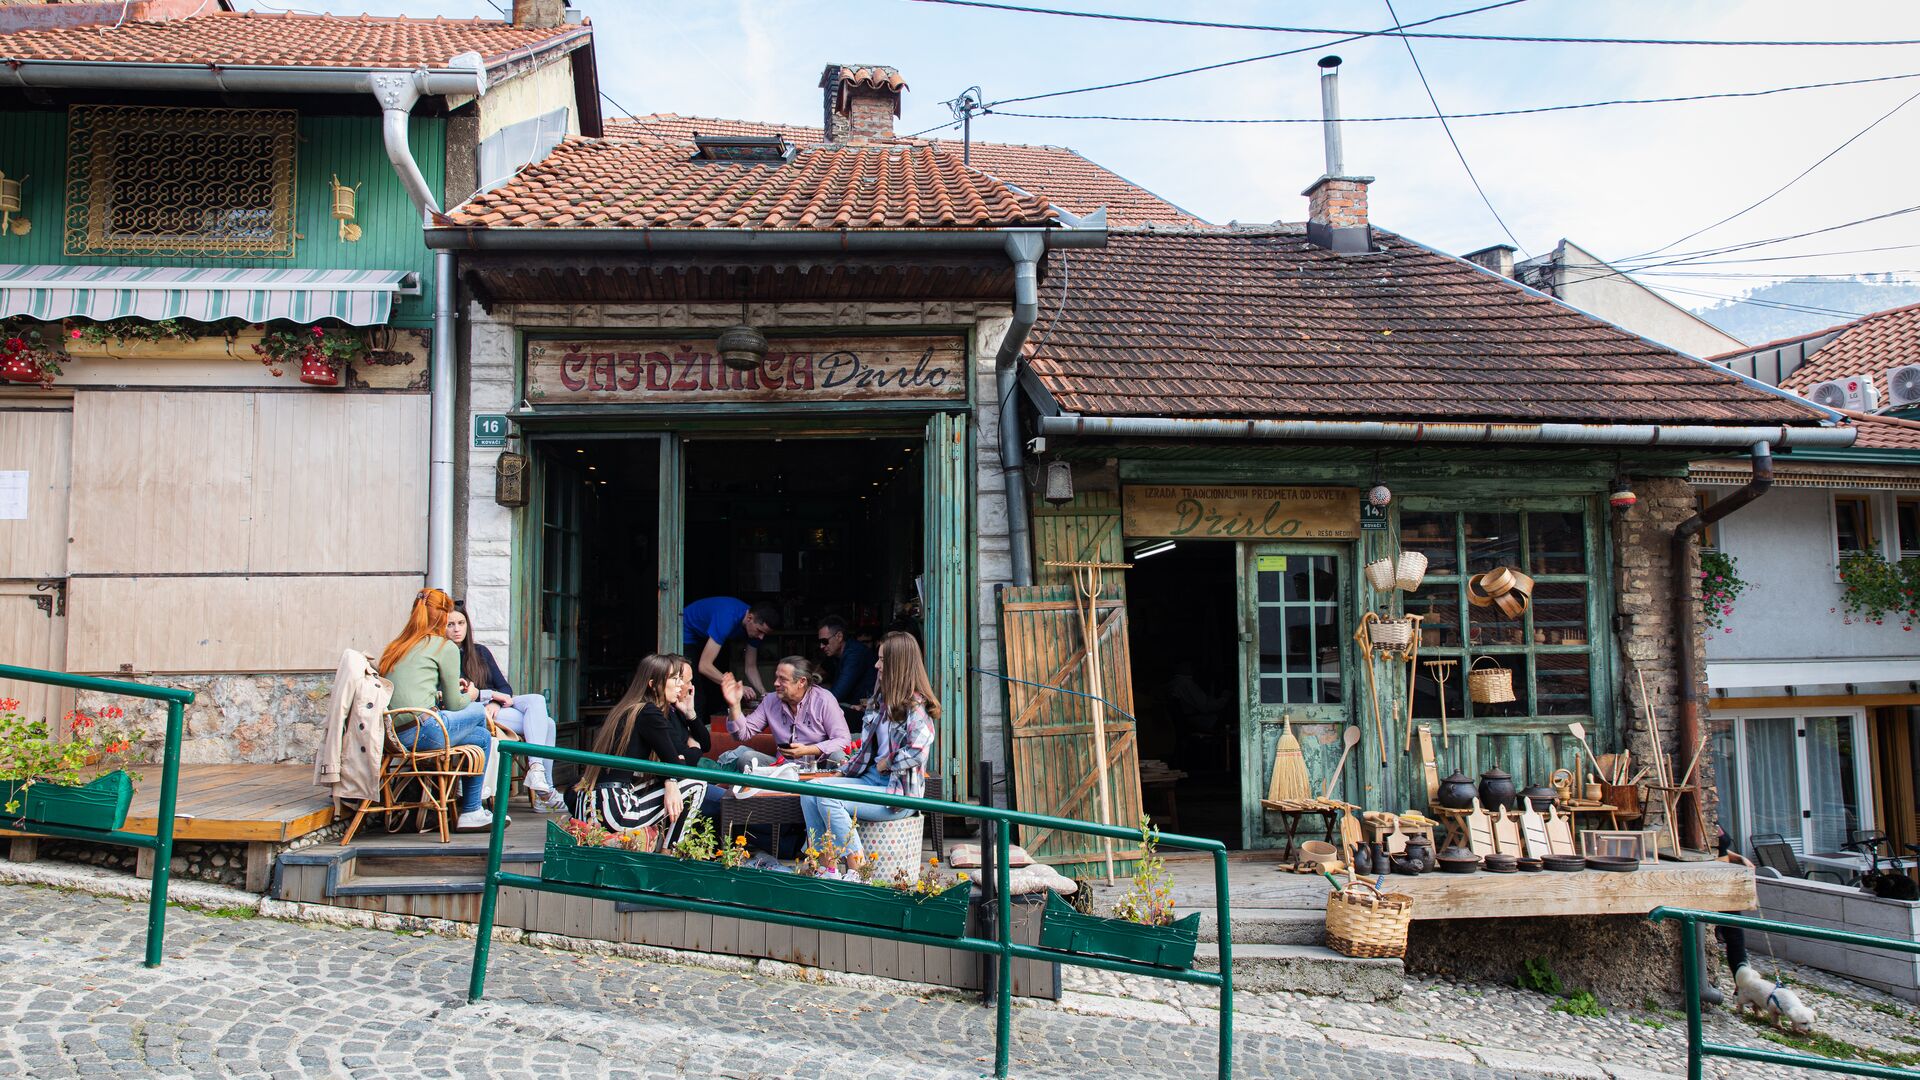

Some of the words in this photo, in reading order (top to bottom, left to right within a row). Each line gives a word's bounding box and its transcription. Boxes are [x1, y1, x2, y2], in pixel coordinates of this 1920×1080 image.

[818, 347, 950, 388] Džirlo
[483, 420, 499, 433] 16
[1144, 488, 1177, 498] IZRADA
[1181, 488, 1248, 499] TRADICIONALNIH
[1252, 489, 1298, 500] PREDMETA
[1300, 489, 1311, 500] OD
[1313, 489, 1347, 500] DRVETA
[1169, 498, 1303, 536] Džirlo
